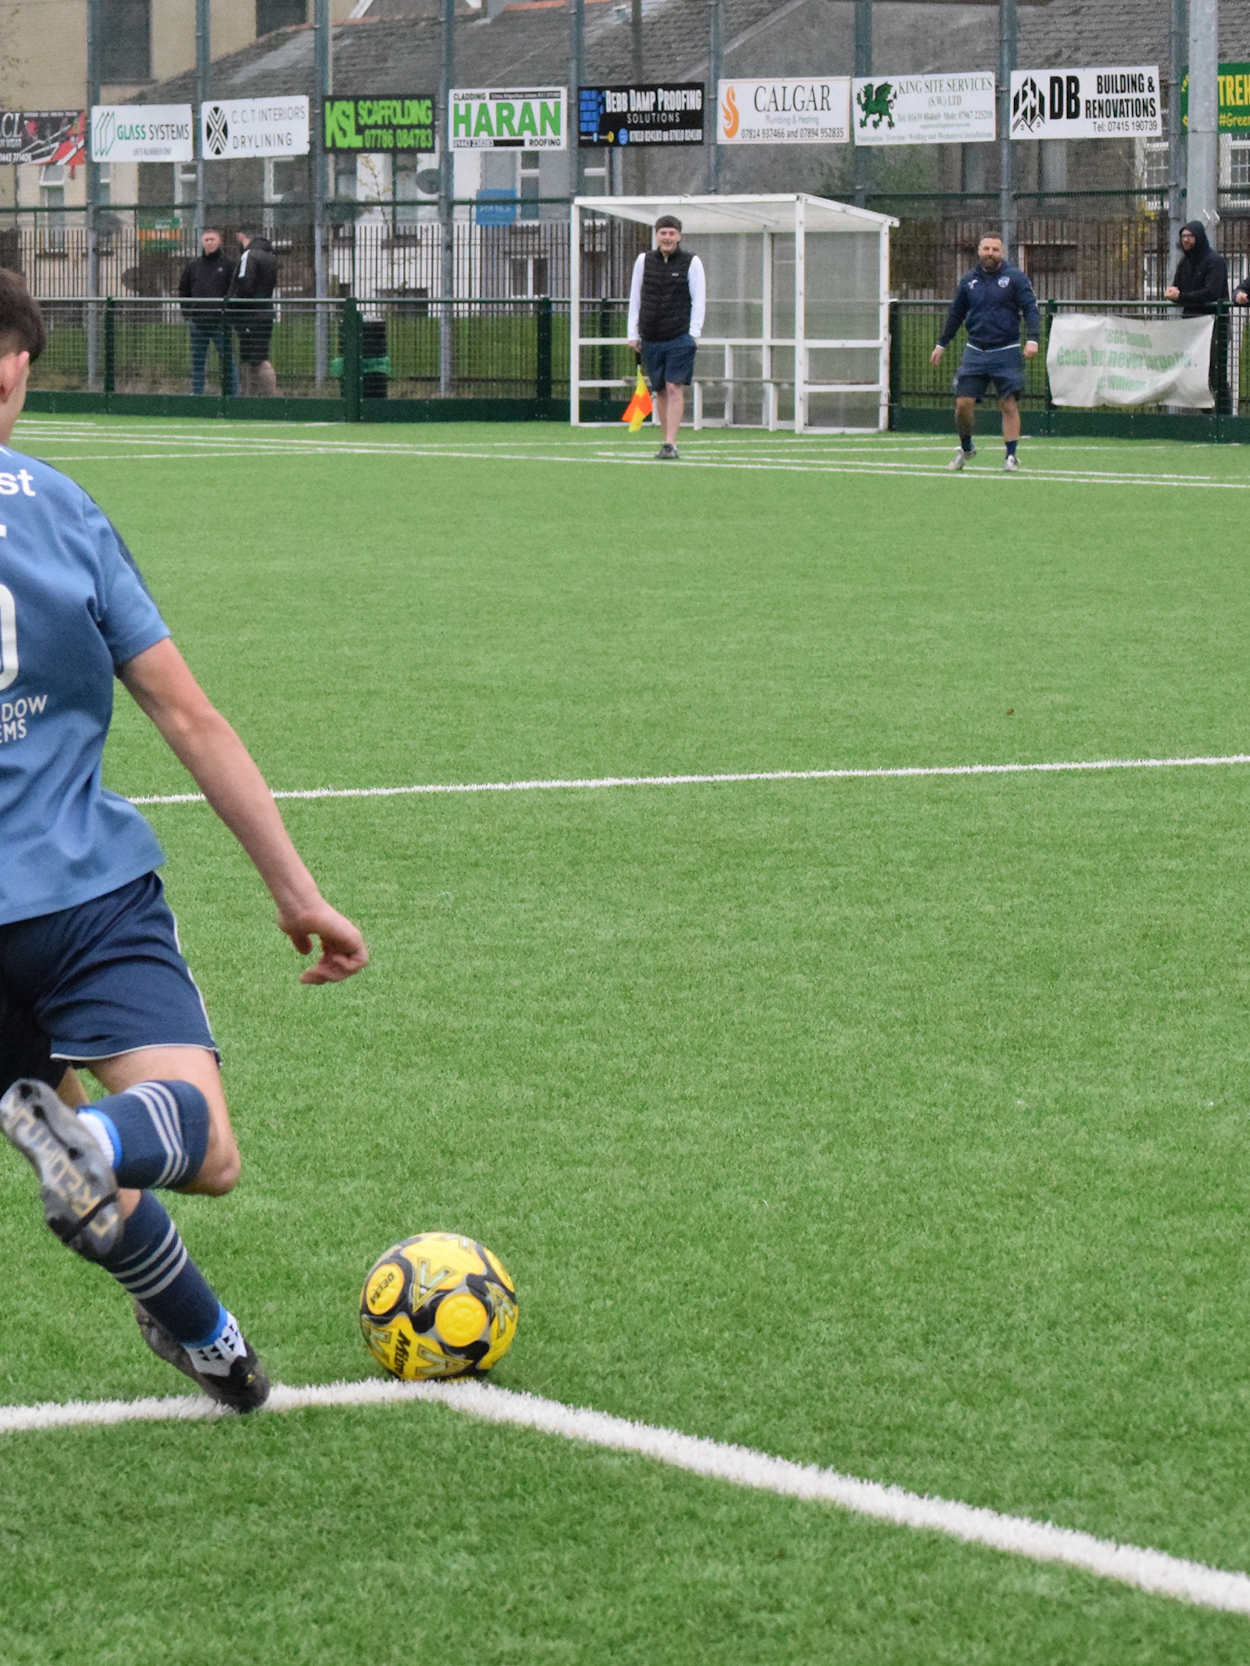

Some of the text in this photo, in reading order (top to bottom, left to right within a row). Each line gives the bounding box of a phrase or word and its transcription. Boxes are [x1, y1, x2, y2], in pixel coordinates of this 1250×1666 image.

[898, 77, 993, 95] KING SITE SERVICES
[1097, 73, 1155, 94] BUILDING &
[453, 93, 486, 101] CLADDING
[629, 89, 656, 112] DAMP
[657, 88, 702, 111] PROOFING
[754, 85, 831, 112] CALGAR
[948, 95, 962, 106] LTD
[1050, 75, 1080, 119] DB
[258, 106, 305, 122] INTERIORS
[358, 99, 432, 125] SCAFFOLDING
[1085, 98, 1157, 118] RENOVATIONS
[325, 101, 363, 148] KSL
[453, 101, 561, 138] HARAN
[627, 112, 681, 124] SOLUTIONS
[1093, 120, 1158, 132] Tel: 07415 190739
[1219, 112, 1250, 128] #Gree
[117, 123, 190, 140] GLASS SYSTEMS
[786, 129, 798, 138] and
[232, 132, 292, 150] DRYLINING
[529, 138, 561, 147] ROOFING
[1057, 346, 1087, 366] Gone
[394, 1328, 411, 1375] Mitr
